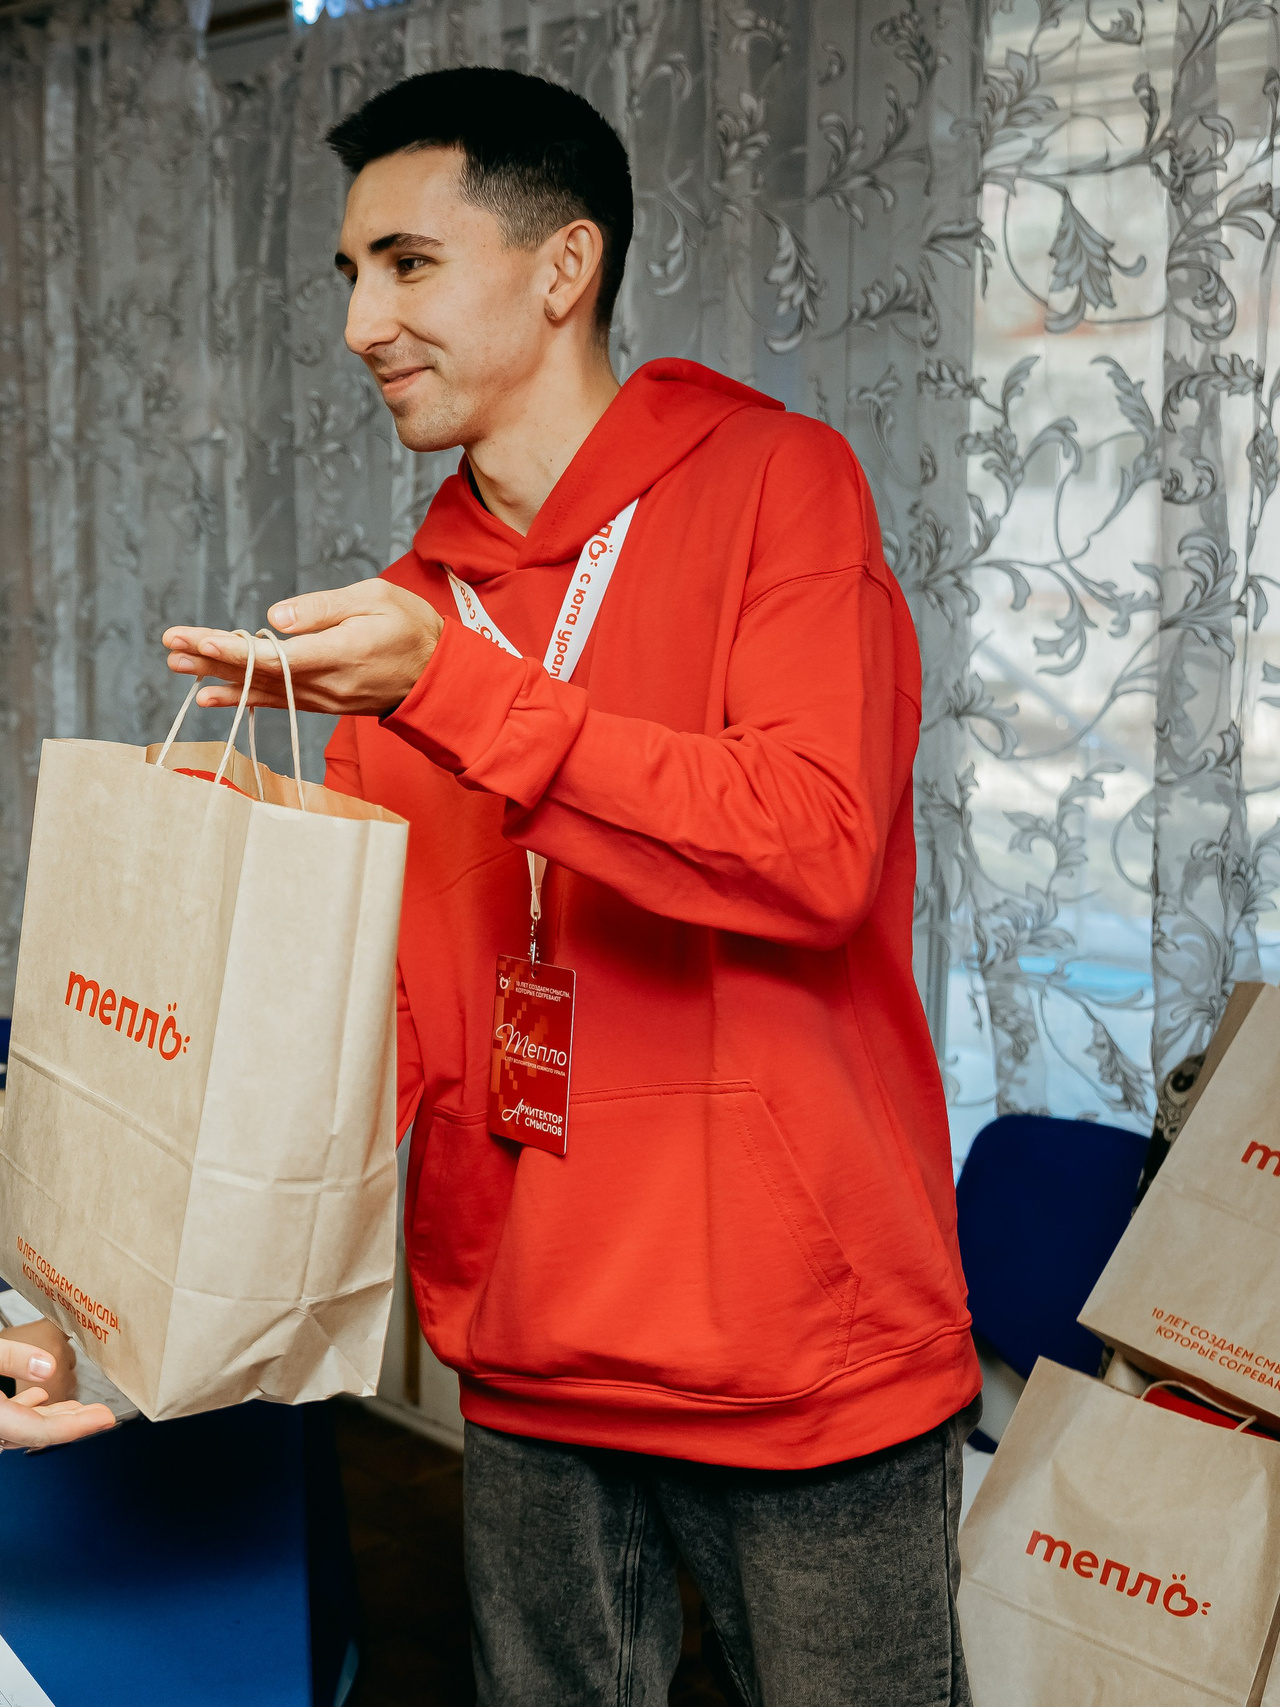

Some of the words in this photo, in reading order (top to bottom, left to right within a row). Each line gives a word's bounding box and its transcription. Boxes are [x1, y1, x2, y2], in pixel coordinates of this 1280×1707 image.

[565, 588, 586, 626] юга
[65, 970, 183, 1061] тепло
[524, 1116, 562, 1137] СМЫСЛОВ
[22, 1261, 57, 1302] КОТОРЫЕ
[23, 1242, 36, 1263] ЛЕТ
[36, 1255, 73, 1297] СОЗДАЕМ
[73, 1287, 121, 1334] СМЫСЛЫ,
[1151, 1307, 1164, 1319] 10
[1163, 1313, 1190, 1331] ЛЕТ
[1189, 1325, 1255, 1362] СОЗДАЕМ
[1156, 1325, 1218, 1362] КОТОРЫЕ
[1025, 1530, 1199, 1618] тепло
